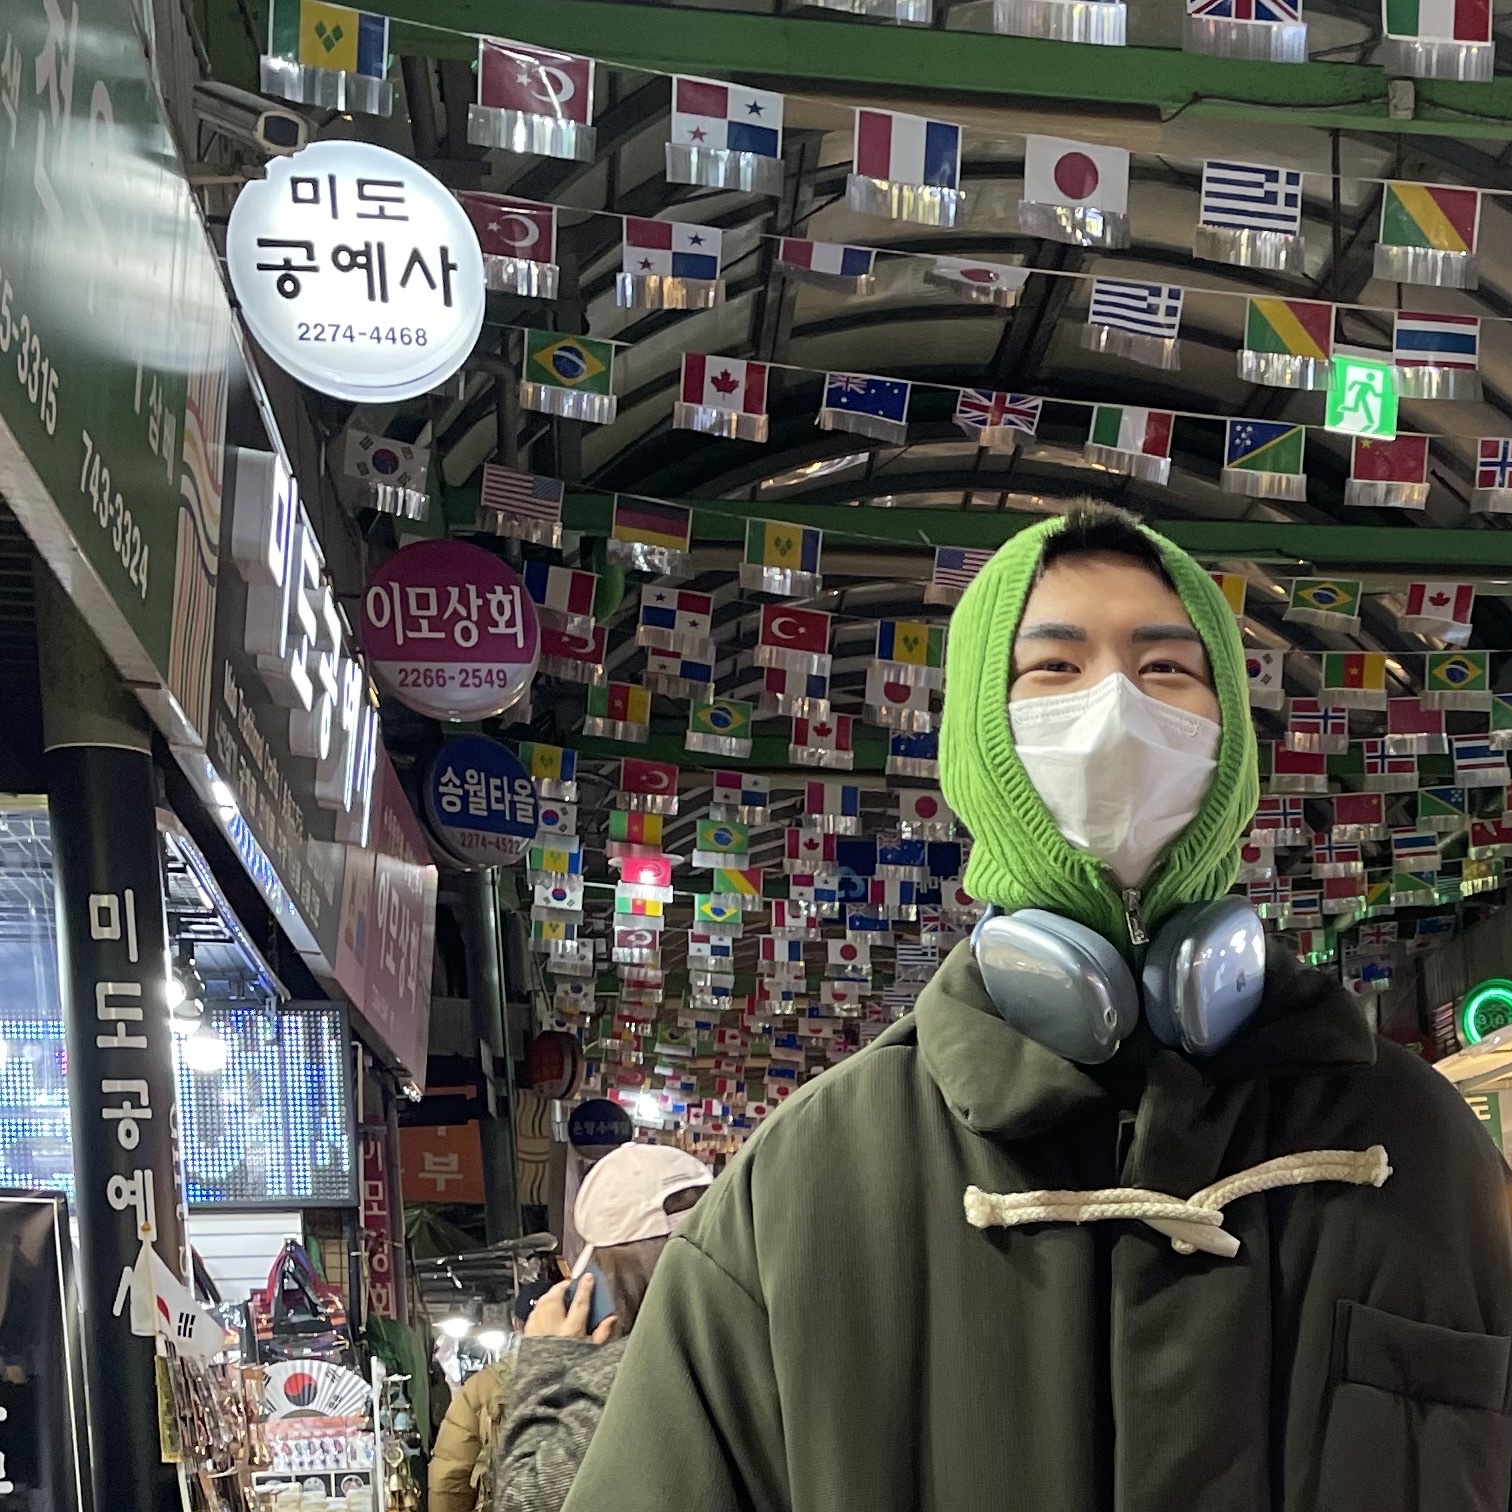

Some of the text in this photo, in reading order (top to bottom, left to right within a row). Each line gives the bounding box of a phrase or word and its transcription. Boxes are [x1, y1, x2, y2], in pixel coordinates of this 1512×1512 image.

[289, 174, 409, 222] 미도
[256, 237, 458, 307] 공예사
[0, 278, 59, 436] 5-3315
[297, 321, 428, 348] 2274-4468
[81, 429, 149, 600] 743-3324
[366, 580, 525, 650] 이모상회
[398, 668, 508, 690] 2266-2549
[439, 766, 537, 823] 송월타올
[377, 869, 420, 1017] 이모상회
[417, 1152, 464, 1192] 부
